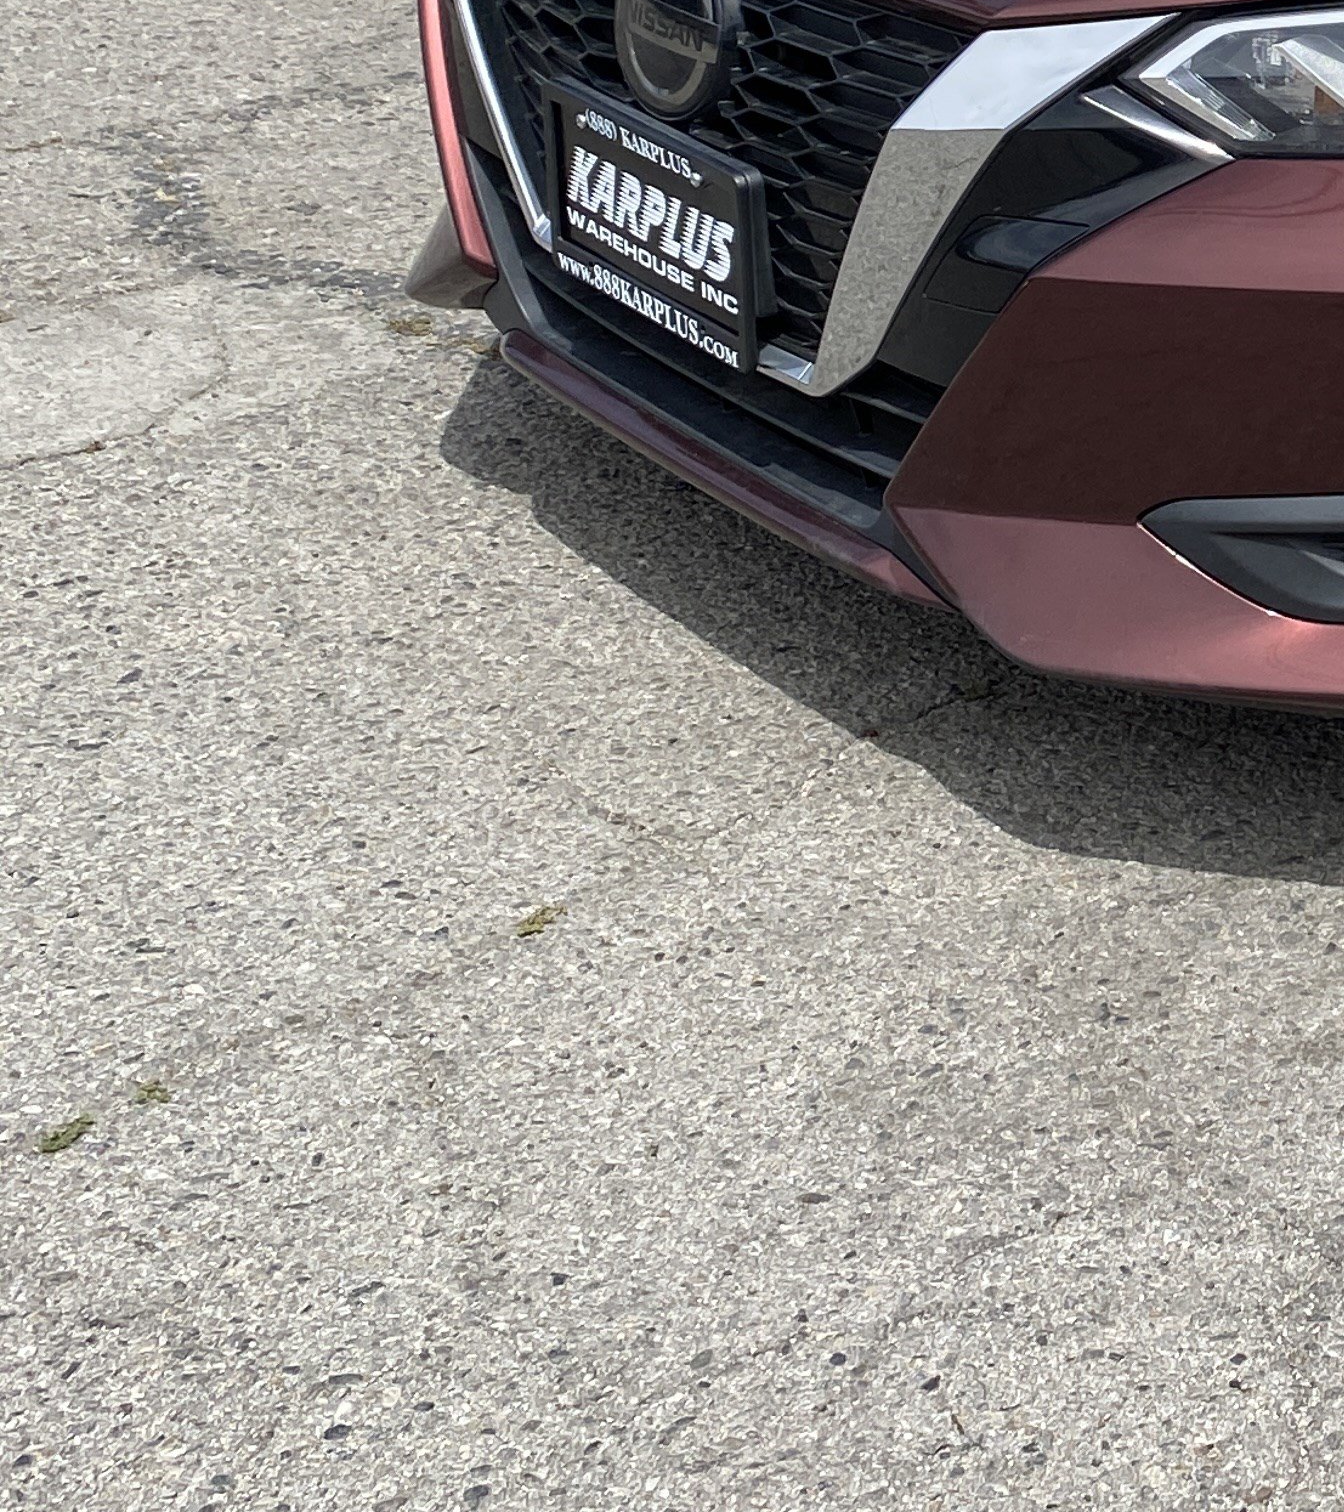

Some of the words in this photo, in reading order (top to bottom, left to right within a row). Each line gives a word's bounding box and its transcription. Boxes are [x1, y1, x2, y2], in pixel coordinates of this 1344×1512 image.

[585, 108, 618, 141] (888)
[620, 127, 692, 178] KARPLUS
[567, 145, 735, 283] KARPLUS
[567, 206, 695, 293] WAREHOUSE
[701, 280, 739, 315] INC
